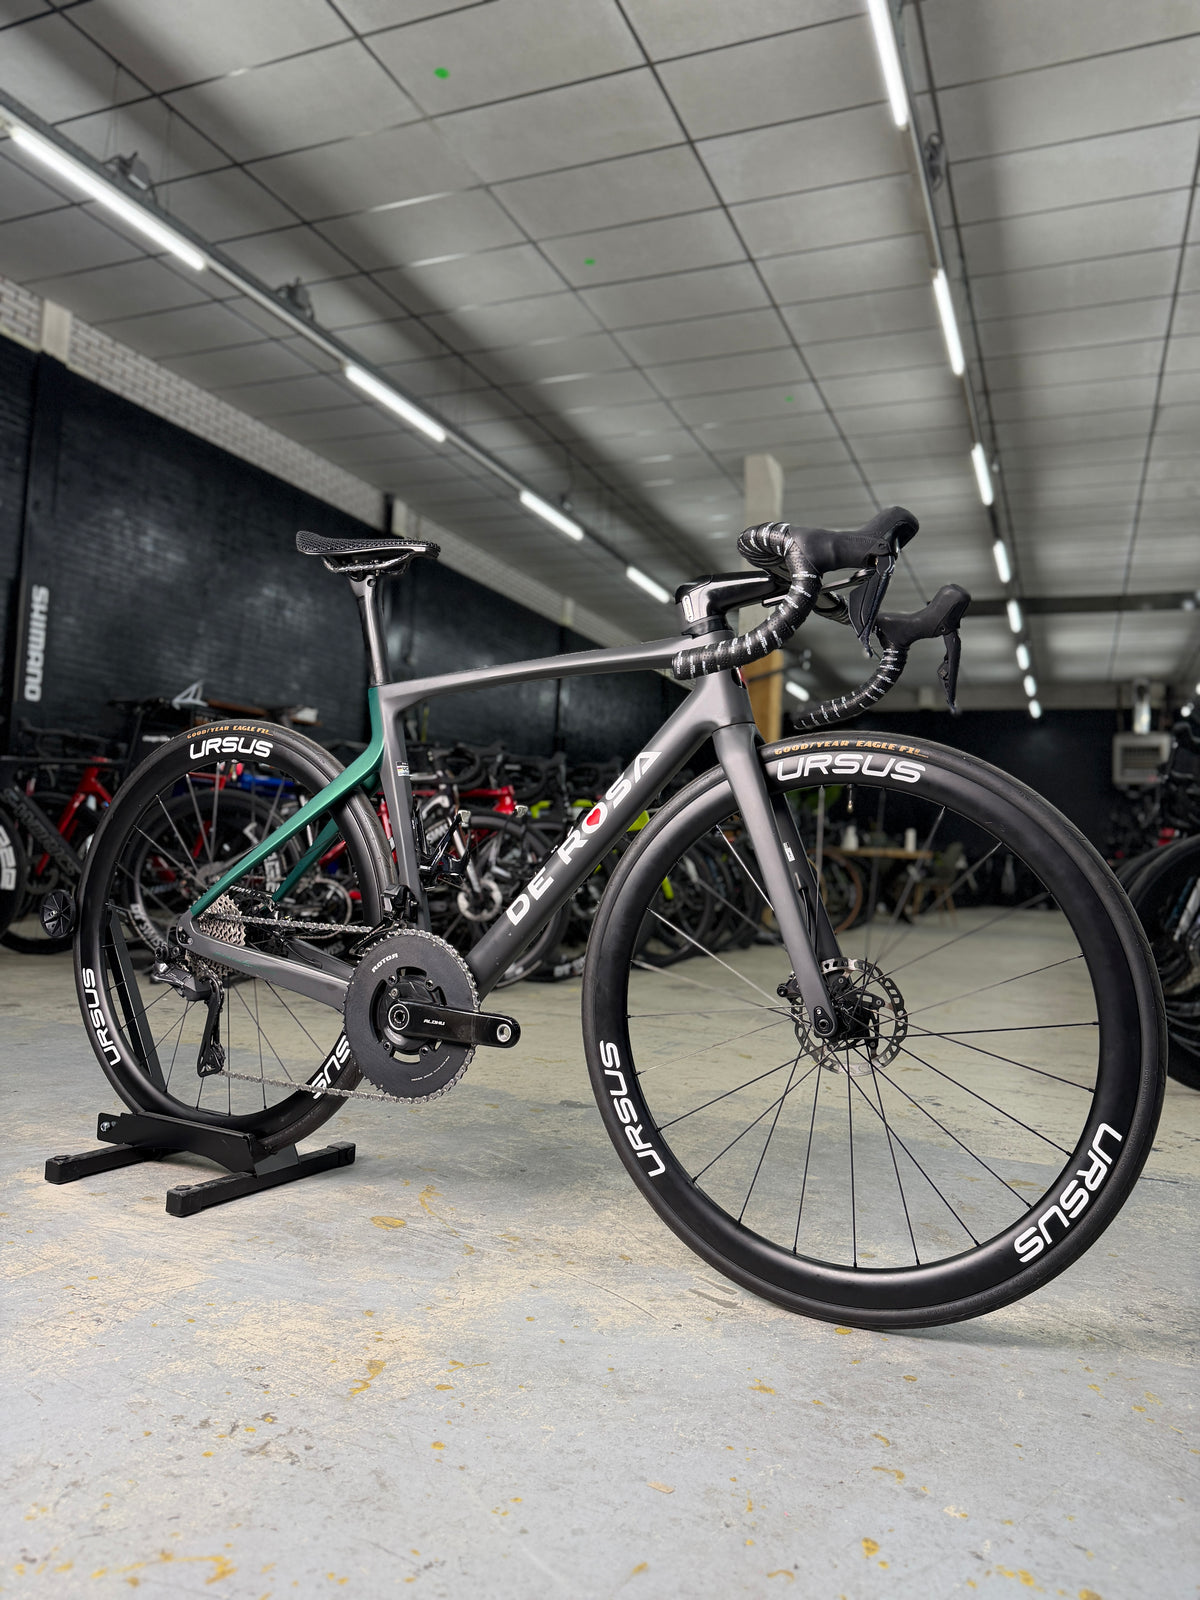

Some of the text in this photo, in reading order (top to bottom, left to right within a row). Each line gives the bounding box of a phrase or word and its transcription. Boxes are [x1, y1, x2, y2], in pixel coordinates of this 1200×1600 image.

[24, 585, 50, 702] SHIMANO
[189, 736, 274, 760] URSUS
[232, 725, 256, 733] EAGLE
[855, 740, 898, 751] EAGLE
[776, 753, 927, 784] URSUS
[506, 751, 663, 926] DE ROSA
[139, 921, 166, 948] SWIS
[371, 952, 399, 973] ROTOR
[82, 968, 121, 1067] URSUS
[312, 1035, 352, 1101] SUS
[599, 1040, 666, 1178] URSUS
[1013, 1122, 1123, 1264] URSUS
